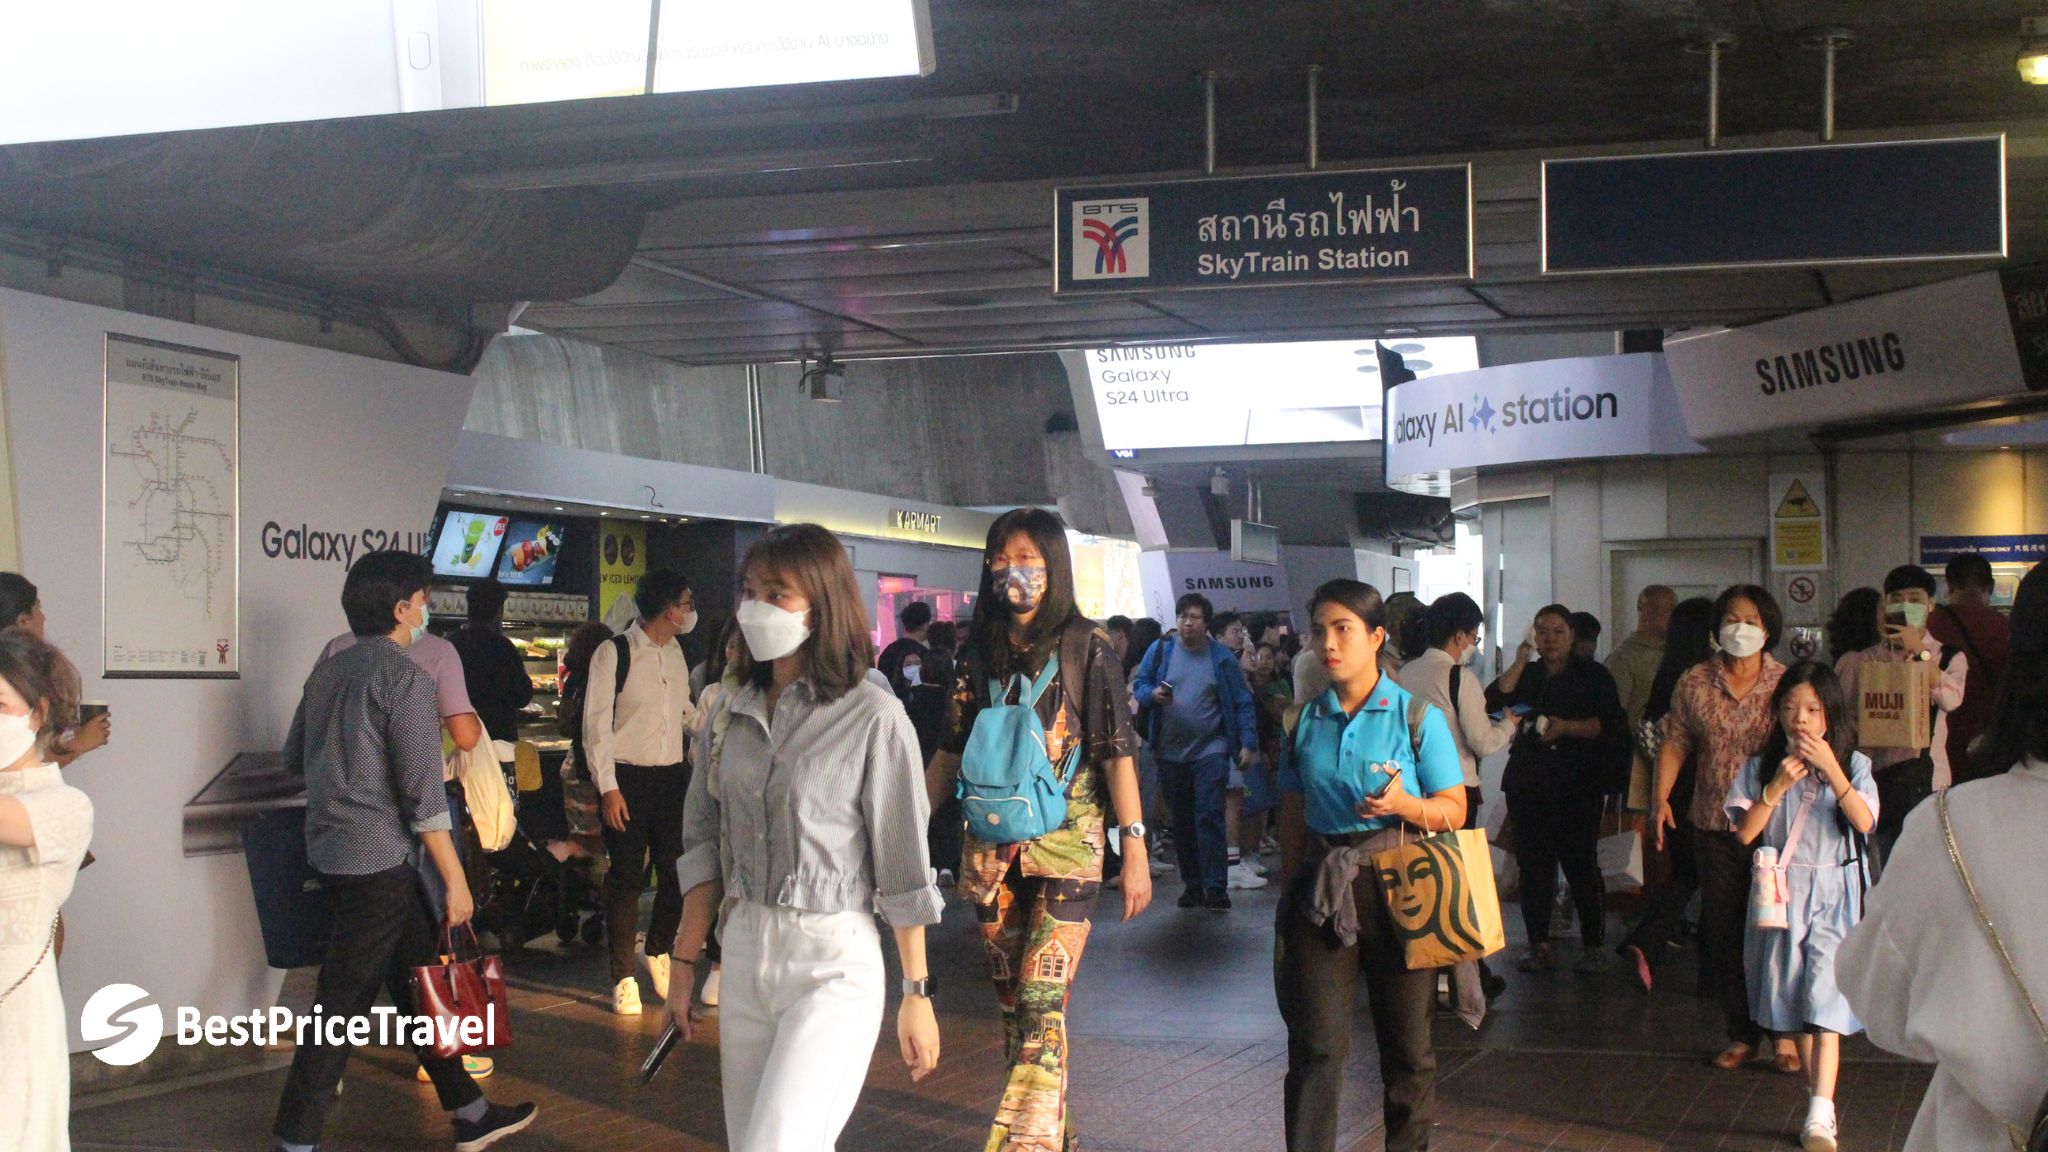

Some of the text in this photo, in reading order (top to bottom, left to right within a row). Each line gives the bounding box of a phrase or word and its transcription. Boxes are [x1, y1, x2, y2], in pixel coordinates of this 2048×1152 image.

[1082, 203, 1138, 215] BTS
[1198, 180, 1420, 242] สถานีรถไฟฟ้า
[1198, 247, 1409, 279] SkyTrain Station
[1097, 345, 1195, 363] SAMSUNG
[1755, 331, 1906, 397] SAMSUNG
[1101, 368, 1171, 384] Galaxy
[1107, 388, 1189, 405] S24 Ultra
[1394, 385, 1618, 448] alaxy AI station
[896, 509, 942, 534] KARMART
[261, 520, 357, 572] Galaxy
[1184, 575, 1274, 590] SAMSUNG
[1864, 692, 1905, 711] MUJI
